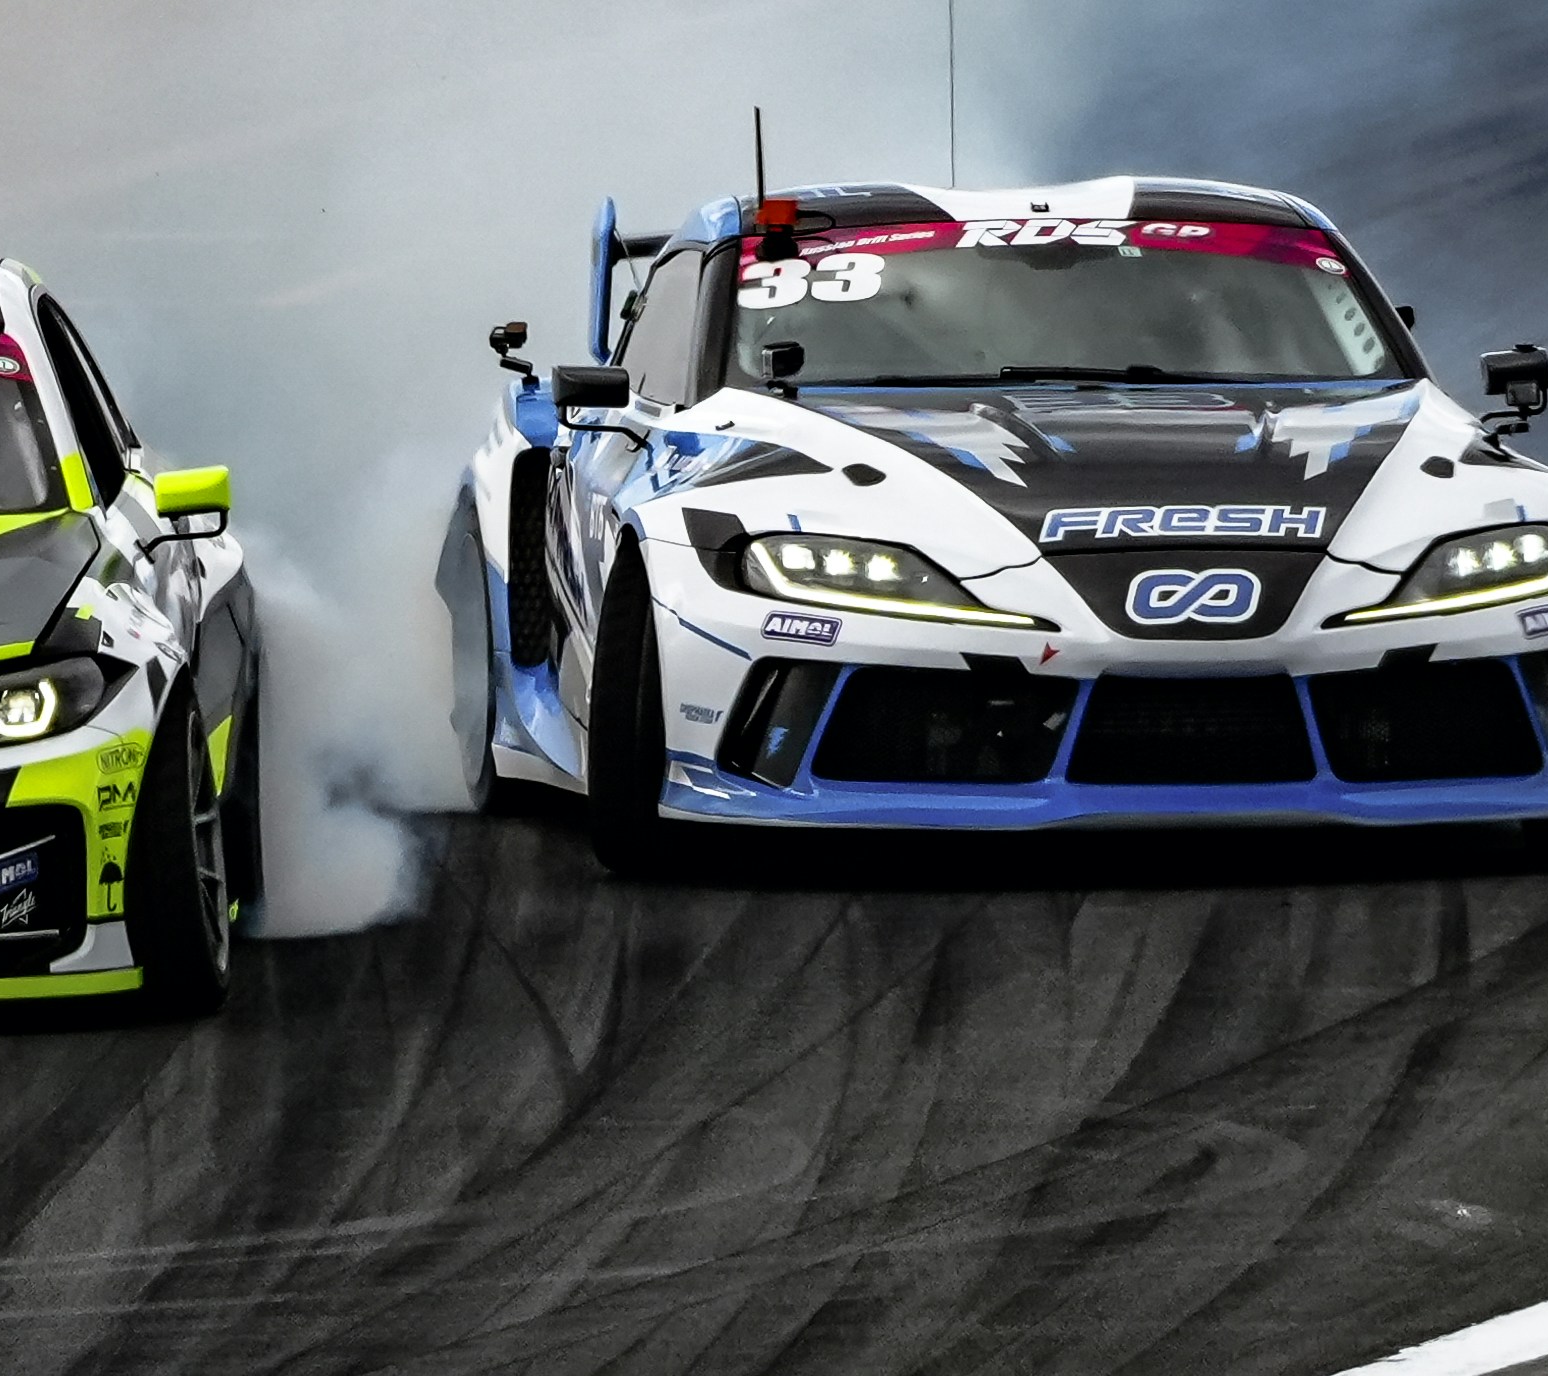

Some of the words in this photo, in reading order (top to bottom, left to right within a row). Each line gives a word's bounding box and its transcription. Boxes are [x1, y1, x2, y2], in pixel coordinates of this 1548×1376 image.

[955, 219, 1138, 248] RDS
[1141, 222, 1210, 238] GP
[737, 252, 886, 310] 33
[764, 616, 835, 638] AIMOL
